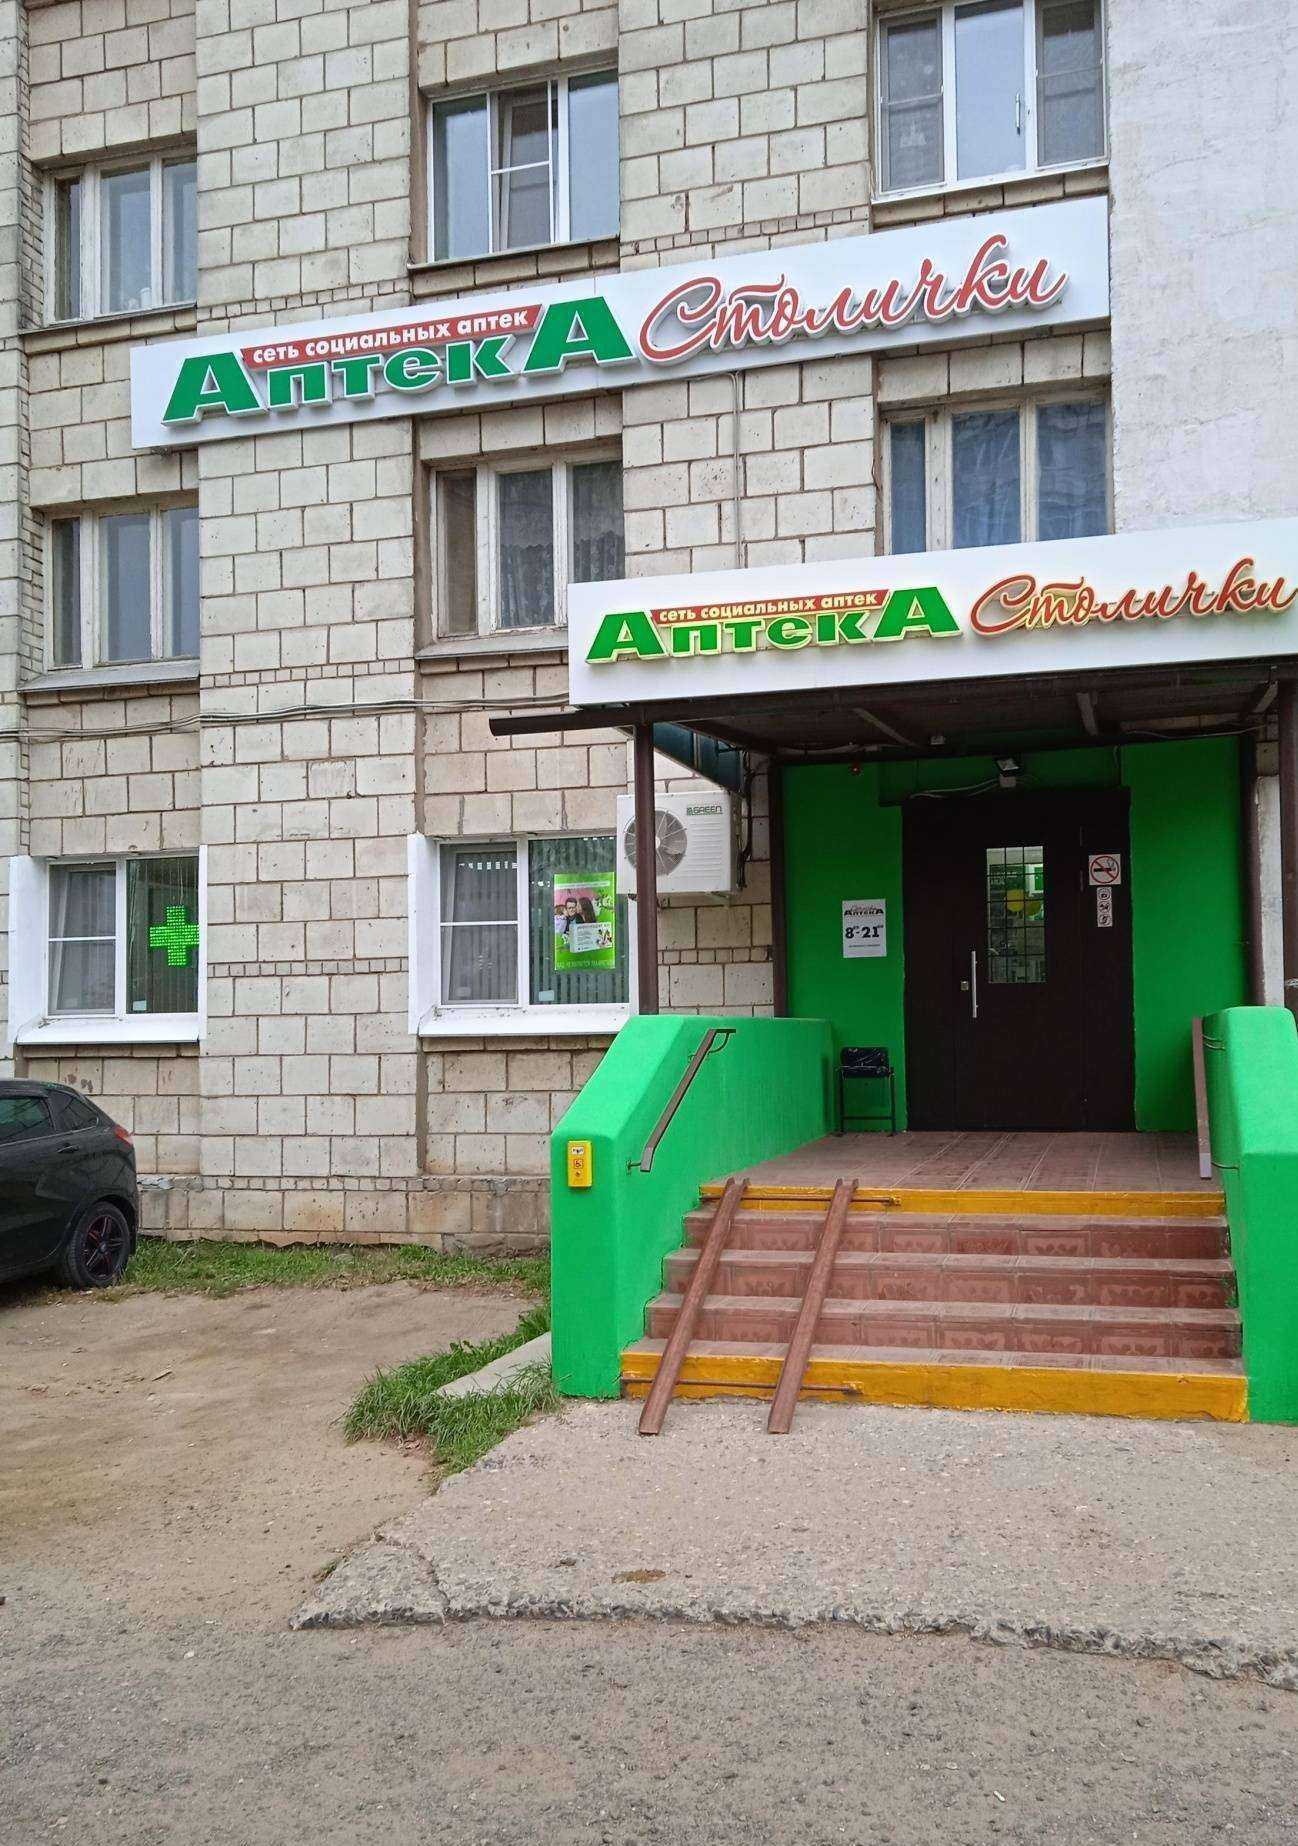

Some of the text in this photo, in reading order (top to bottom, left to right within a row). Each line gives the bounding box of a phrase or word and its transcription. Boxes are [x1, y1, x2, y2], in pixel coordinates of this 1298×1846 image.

[639, 233, 1067, 361] Столички
[253, 309, 528, 363] сеть социальных аптек
[659, 592, 878, 622] сеть социальных аптек
[970, 556, 1298, 638] Столички
